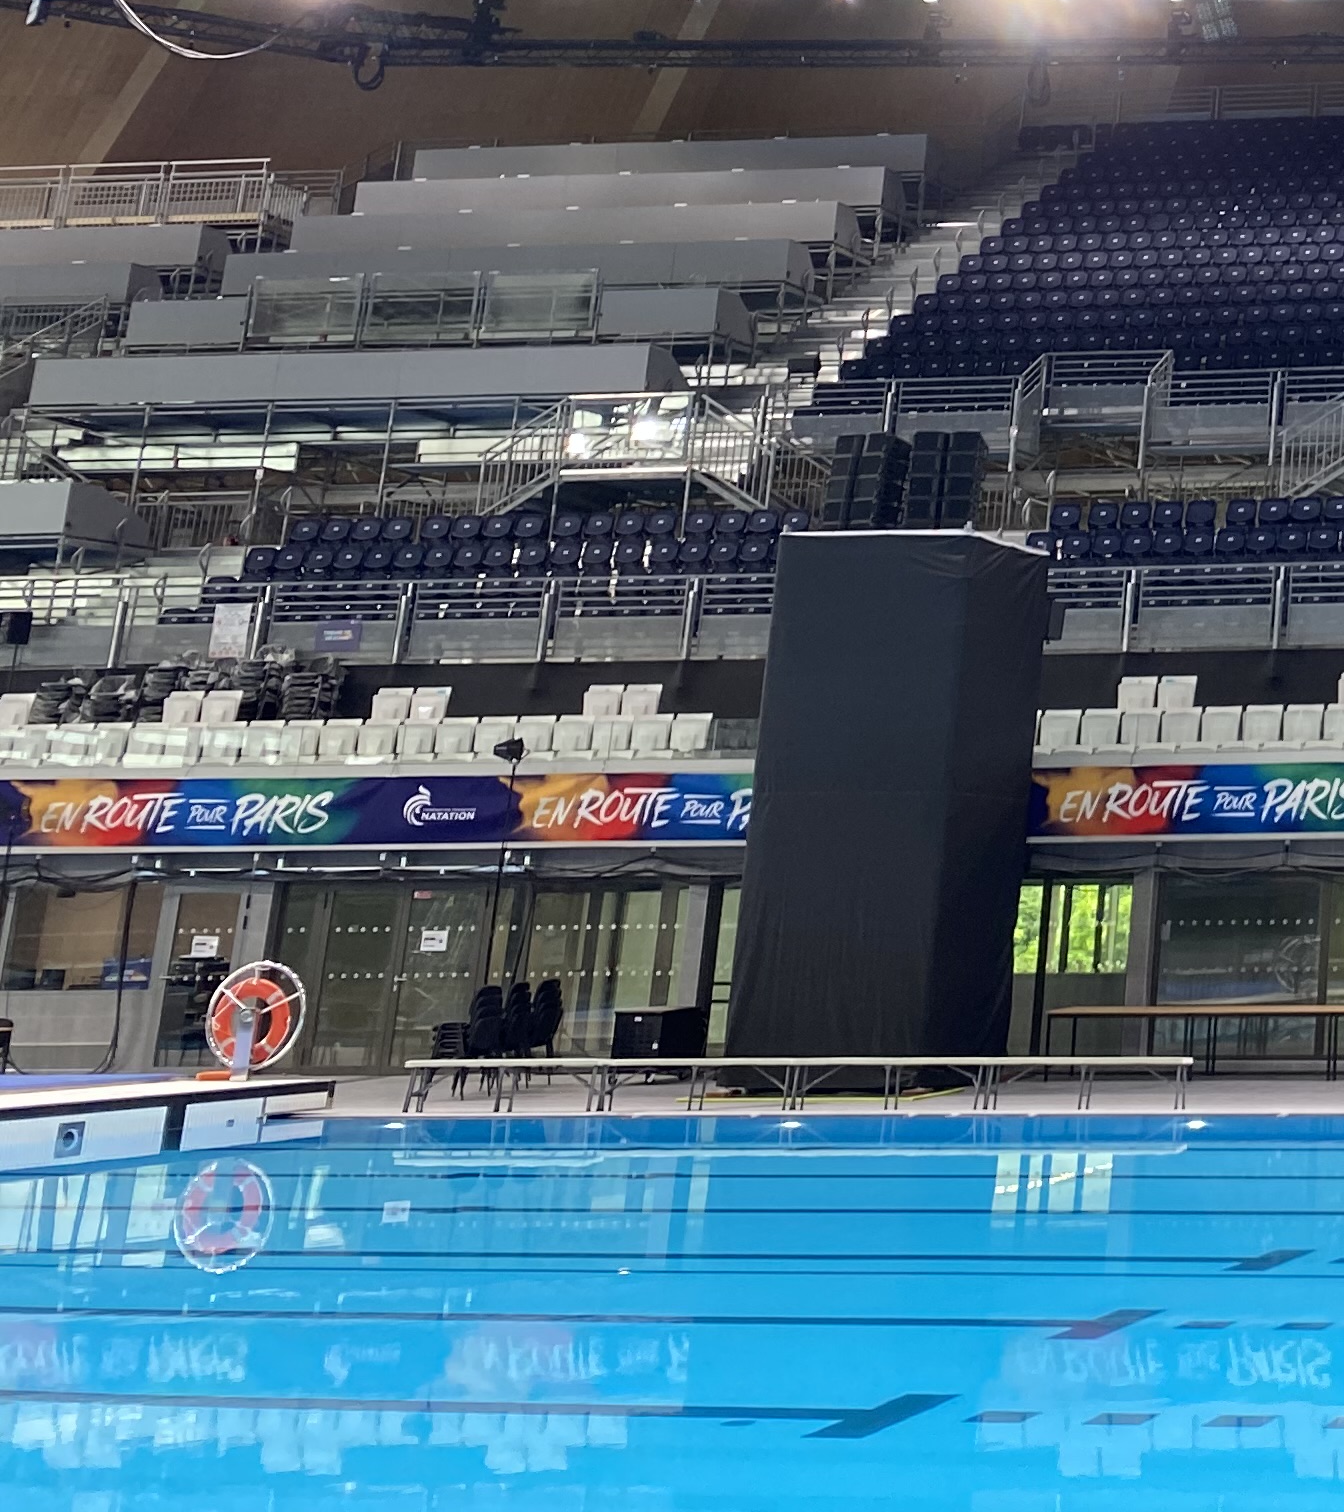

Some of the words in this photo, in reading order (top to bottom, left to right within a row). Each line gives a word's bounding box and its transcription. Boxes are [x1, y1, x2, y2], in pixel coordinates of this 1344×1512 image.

[40, 800, 82, 833] EN
[80, 792, 187, 835] ROUTE
[188, 802, 227, 826] POUR
[231, 790, 334, 836] PARIS
[420, 809, 476, 822] NATATION
[532, 792, 576, 829] EN
[573, 787, 680, 829] ROUTE
[680, 798, 723, 821] POUR
[1059, 790, 1101, 823] EN
[1102, 780, 1210, 823] ROUTE
[1213, 791, 1255, 813] POUR
